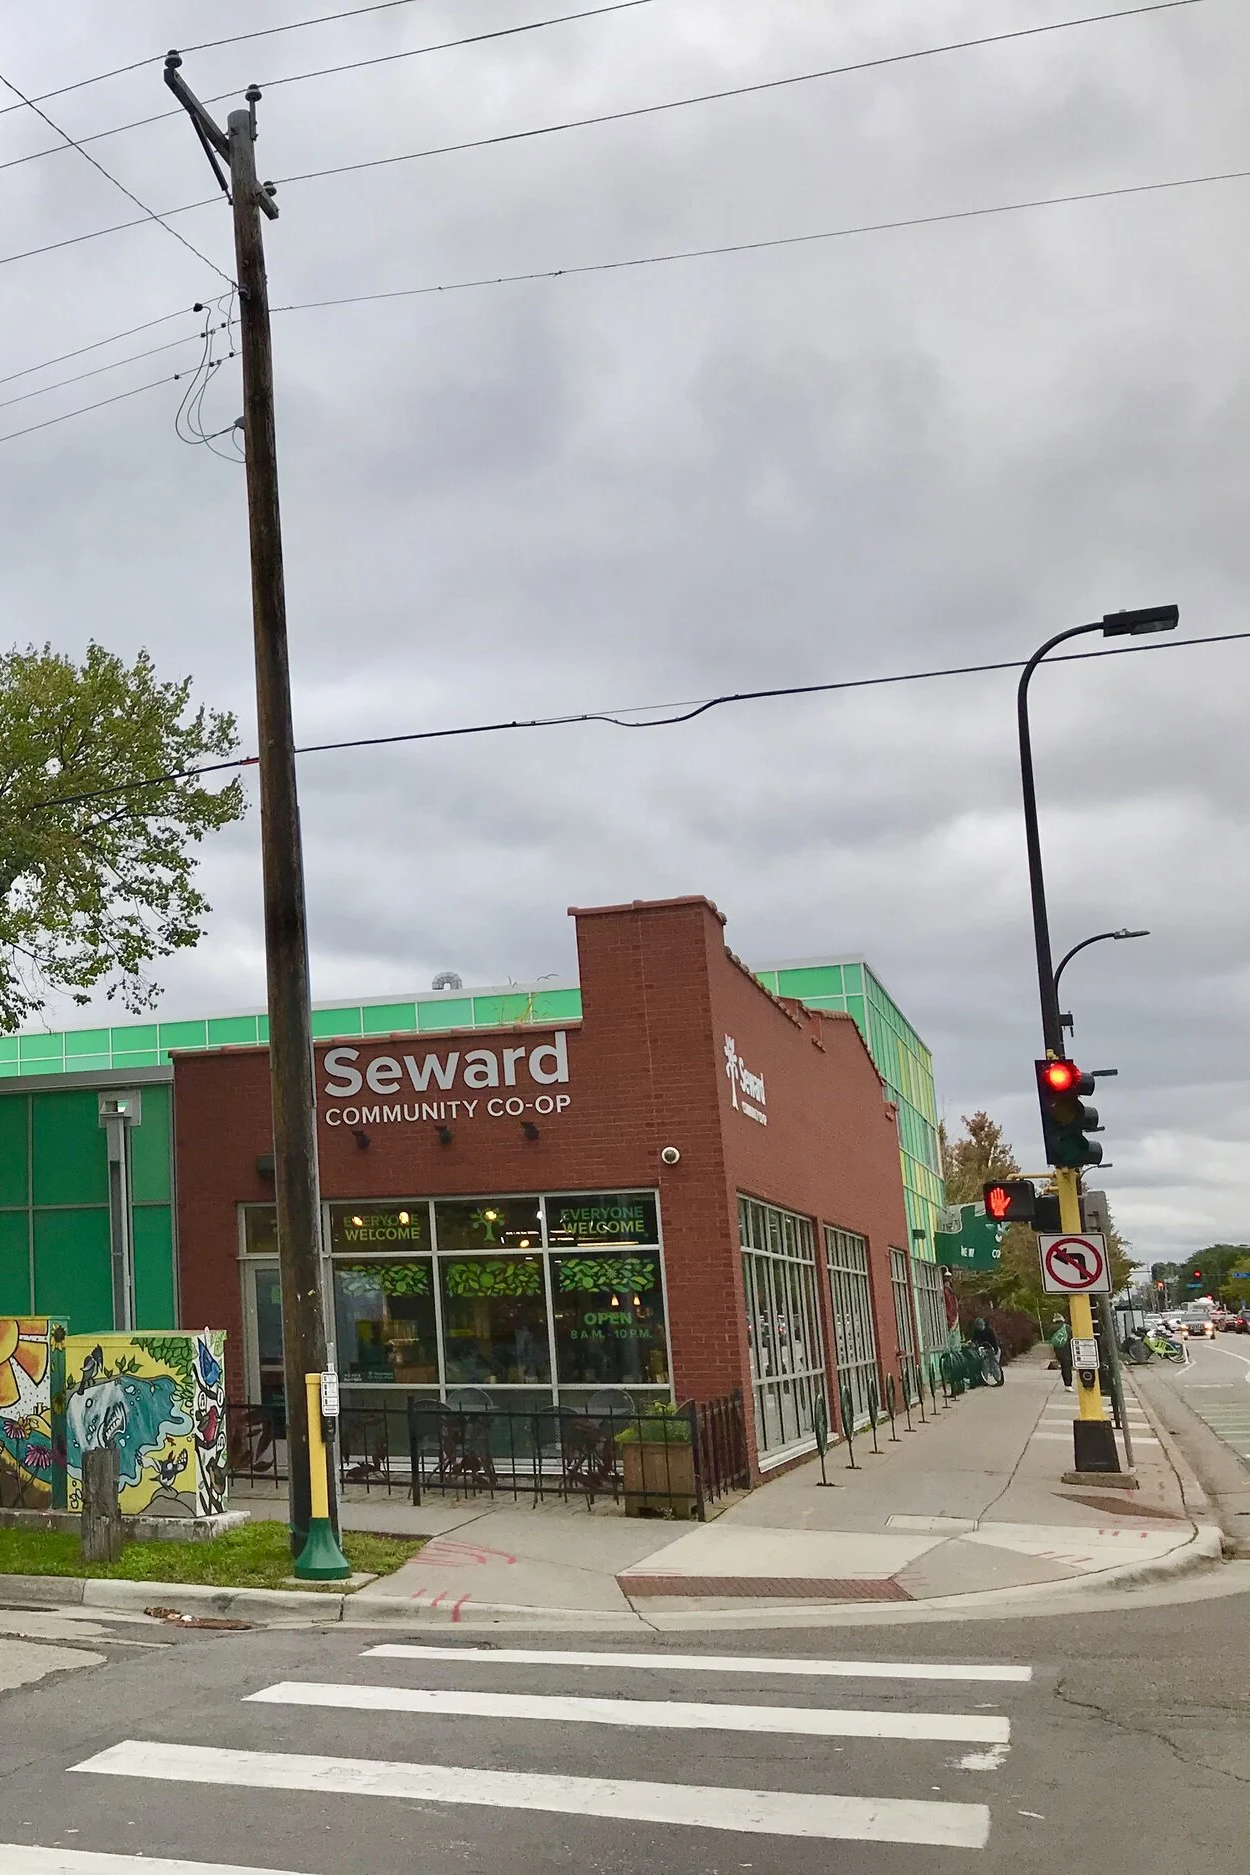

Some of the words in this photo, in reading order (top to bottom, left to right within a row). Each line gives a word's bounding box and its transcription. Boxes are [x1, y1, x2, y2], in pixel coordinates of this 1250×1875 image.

[323, 1031, 570, 1097] Seward
[325, 1099, 479, 1126] COMMUNITY
[487, 1094, 571, 1117] CO-OP
[561, 1206, 644, 1220] EVERYONE
[343, 1214, 420, 1227] EERYOE
[562, 1220, 645, 1234] WELCOME
[345, 1228, 420, 1240] WELCOME
[584, 1312, 633, 1325] OPEN
[570, 1330, 578, 1339] 8
[614, 1329, 627, 1338] 10
[630, 1329, 652, 1338] P.M.
